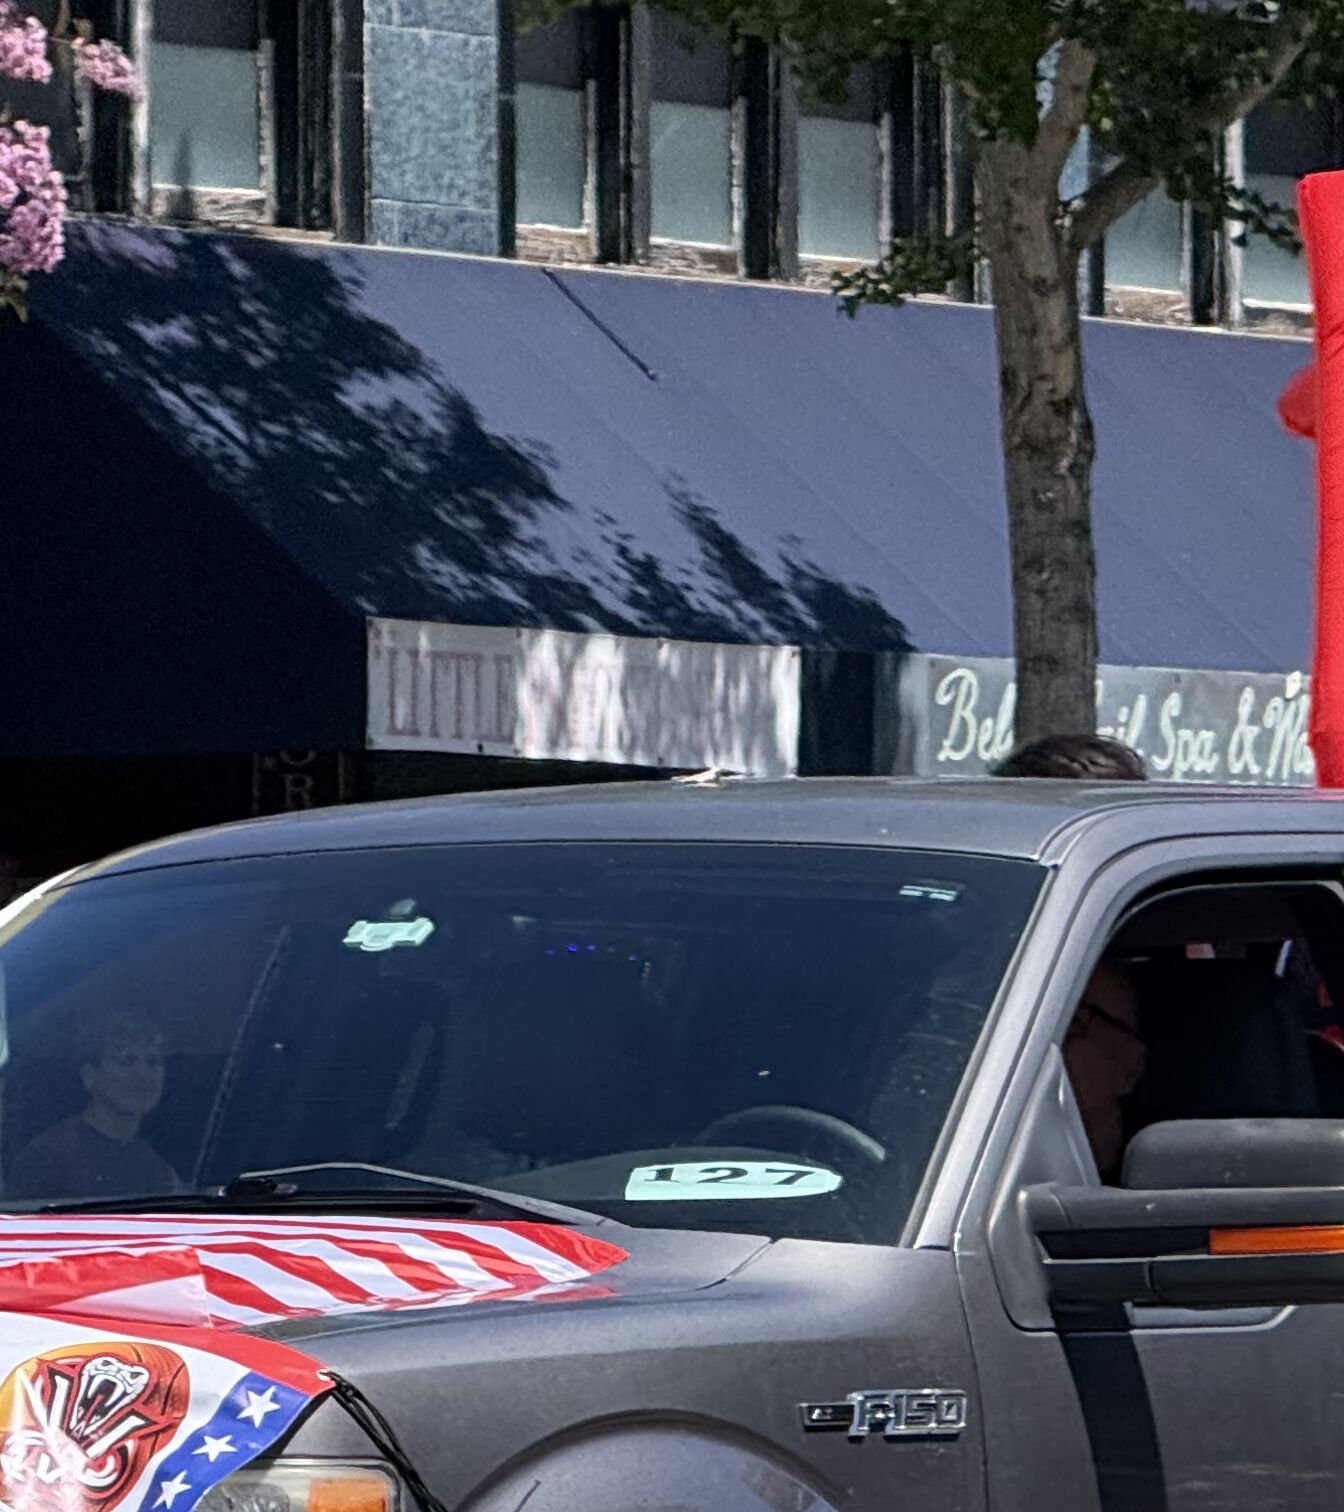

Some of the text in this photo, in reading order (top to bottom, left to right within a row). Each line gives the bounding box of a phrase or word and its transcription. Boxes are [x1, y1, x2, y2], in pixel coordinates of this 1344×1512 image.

[1151, 692, 1218, 781] Spa
[1228, 687, 1261, 775] &
[644, 1166, 816, 1186] 127
